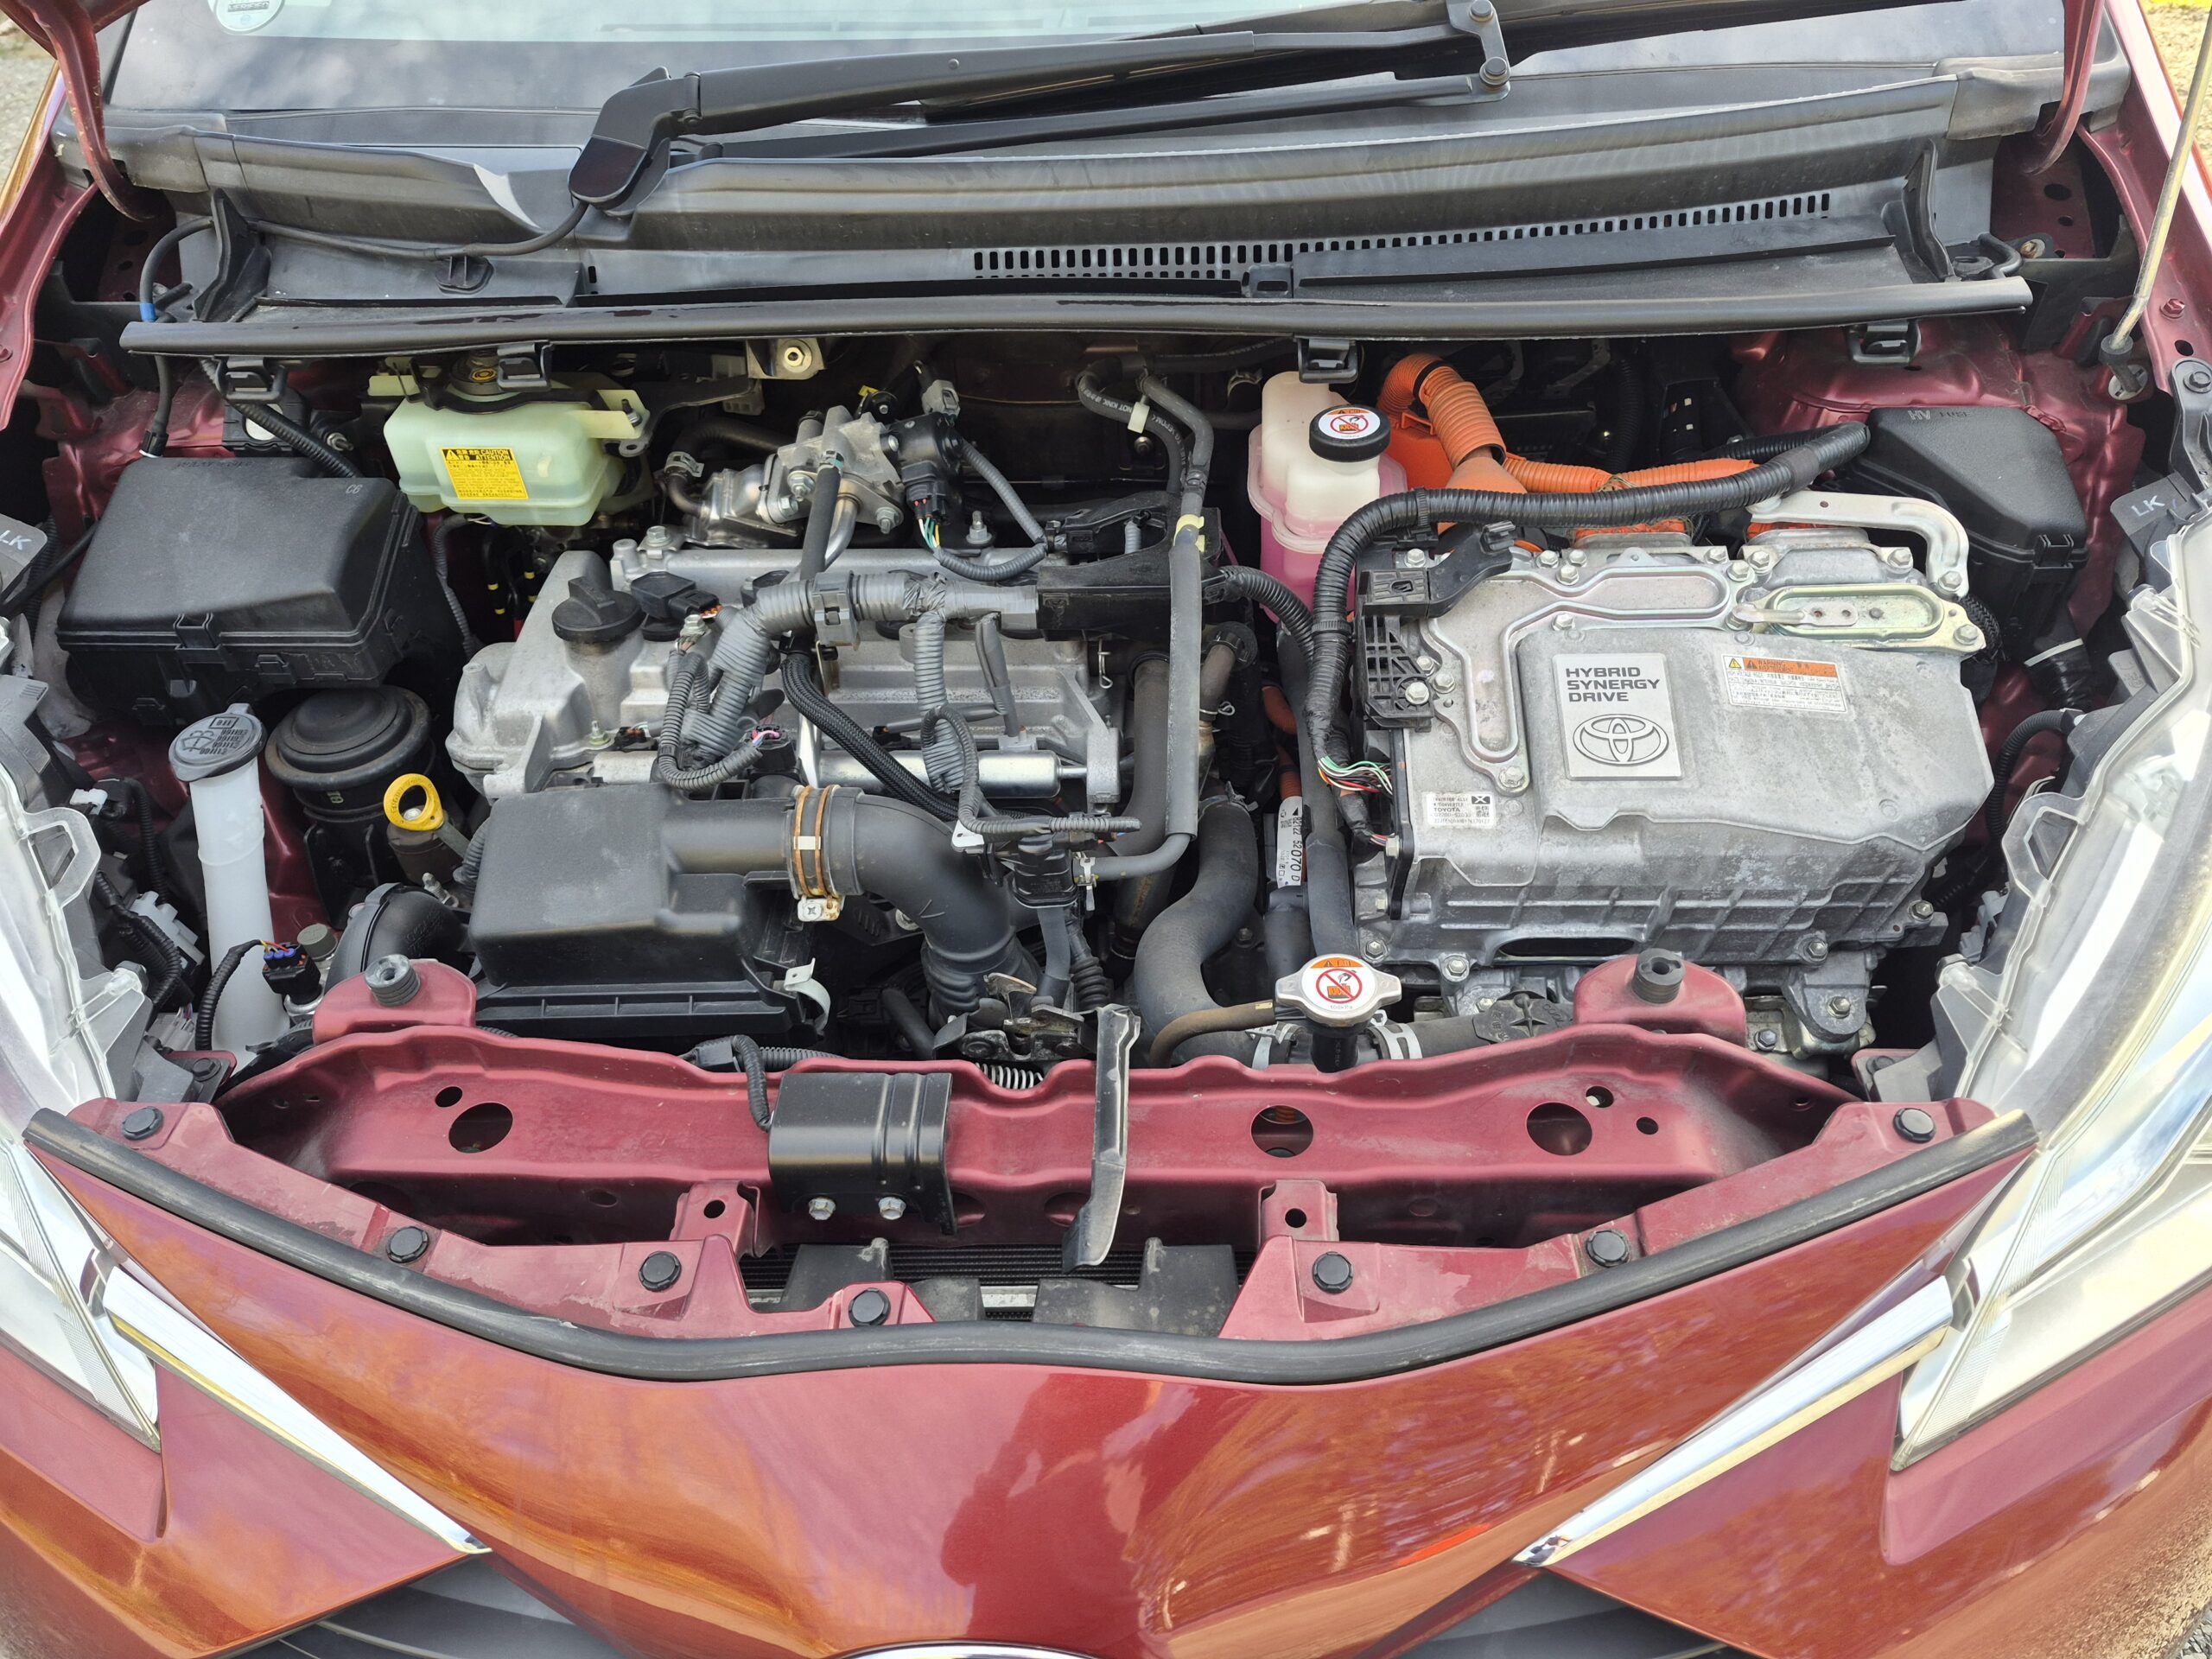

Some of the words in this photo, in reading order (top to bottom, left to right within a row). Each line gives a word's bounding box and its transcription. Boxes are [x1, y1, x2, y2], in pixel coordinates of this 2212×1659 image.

[2131, 495, 2165, 517] LK
[0, 530, 32, 550] LK
[1565, 667, 1641, 677] HYBRID
[1567, 679, 1660, 690] SYNERGY
[1568, 692, 1630, 702] DRIVE
